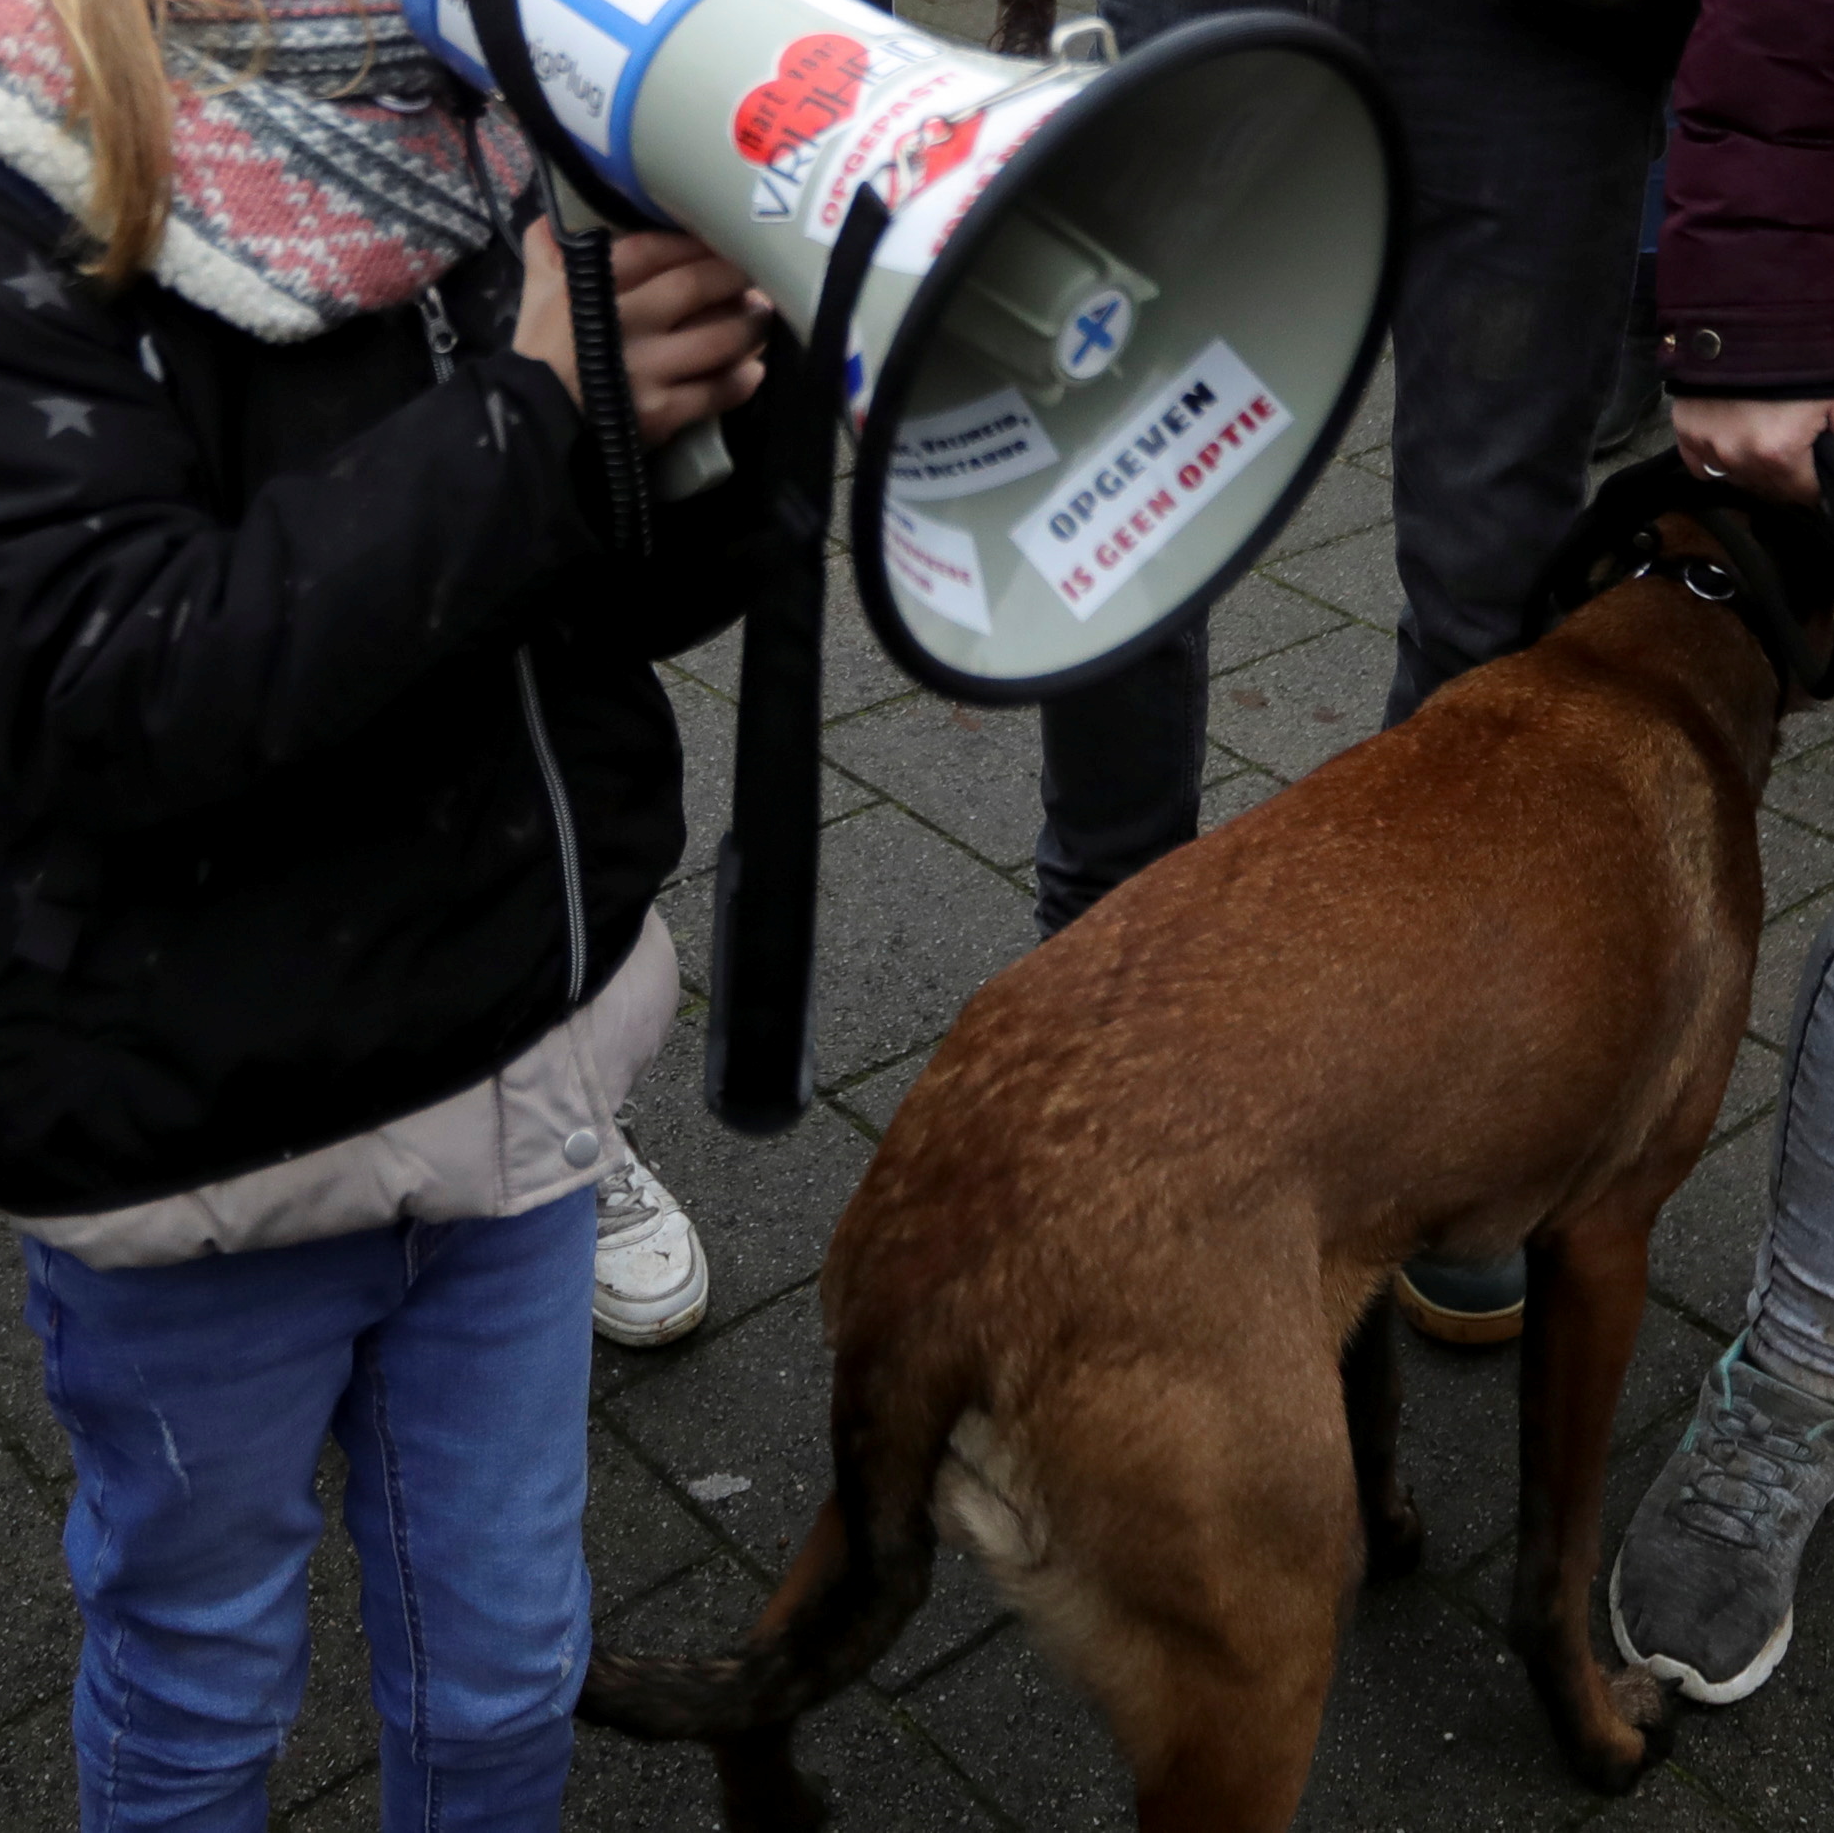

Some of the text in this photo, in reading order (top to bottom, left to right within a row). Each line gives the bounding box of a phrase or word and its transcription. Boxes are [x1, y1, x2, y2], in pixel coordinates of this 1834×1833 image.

[1048, 380, 1219, 544] OPGEVEN
[1059, 394, 1278, 603] IS GEEN OPTIE
